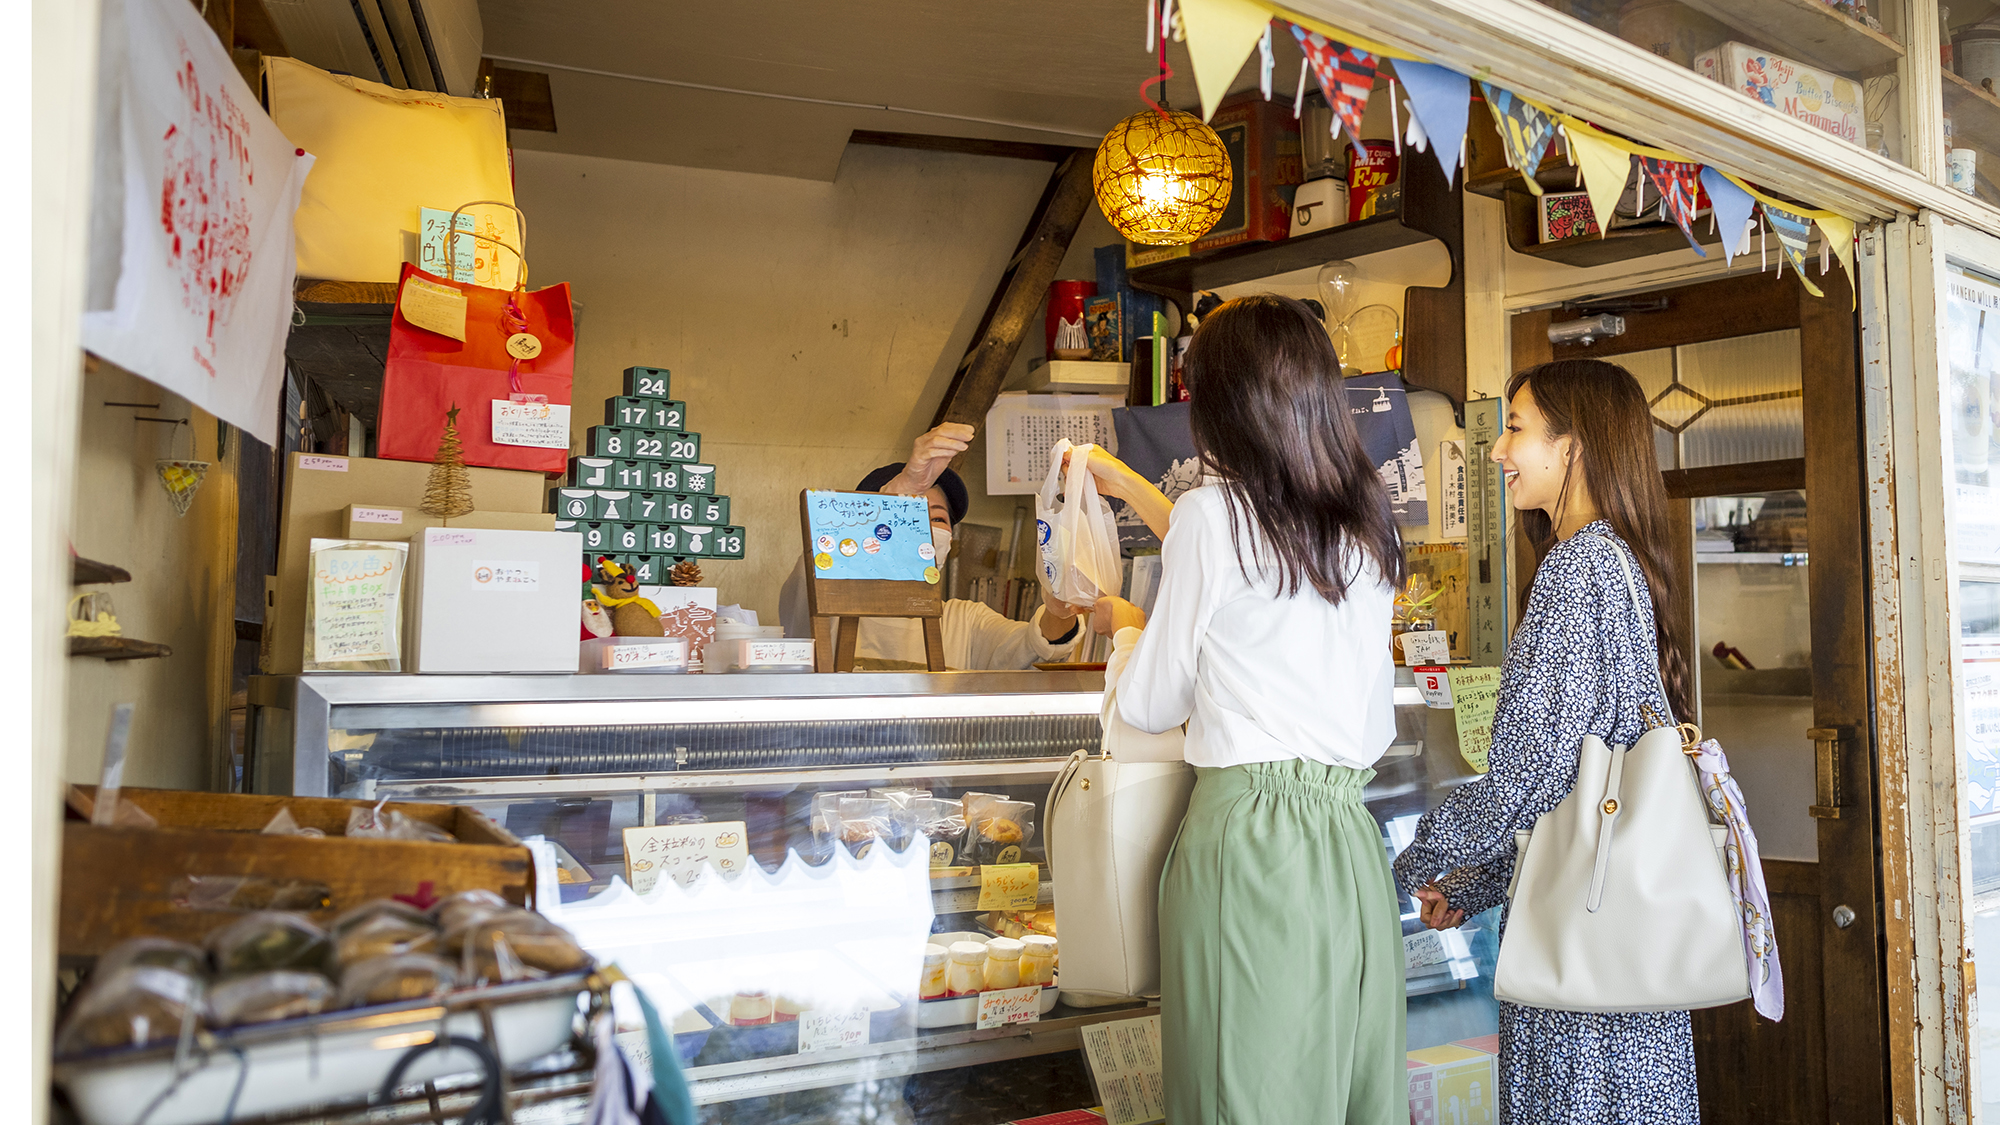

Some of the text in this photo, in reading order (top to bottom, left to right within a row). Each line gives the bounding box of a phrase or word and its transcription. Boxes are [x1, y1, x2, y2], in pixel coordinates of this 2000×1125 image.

[1823, 89, 1859, 115] Biscuits
[1784, 96, 1859, 143] Mammaly
[1355, 157, 1386, 168] MILK
[638, 378, 666, 396] 24
[621, 407, 646, 424] 17
[655, 410, 680, 427] 12
[607, 437, 621, 454] 8
[636, 439, 662, 456] 22
[670, 441, 696, 459] 20
[619, 469, 642, 486] 11
[652, 472, 677, 489] 18
[1457, 465, 1465, 523] 食品衛生責任者
[642, 501, 655, 517] 7
[668, 503, 693, 520] 16
[706, 505, 720, 521] 5
[588, 530, 602, 547] 9
[622, 531, 636, 548] 6
[651, 532, 676, 549] 19
[717, 536, 741, 553] 13
[330, 559, 358, 575] BOX
[637, 564, 651, 580] 4
[641, 835, 706, 854] 全粒粉の
[659, 853, 709, 868] スコーン
[987, 875, 1015, 888] いちじく
[1001, 881, 1029, 895] マフィン
[1008, 1012, 1029, 1023] 370円
[840, 1031, 862, 1041] 370円
